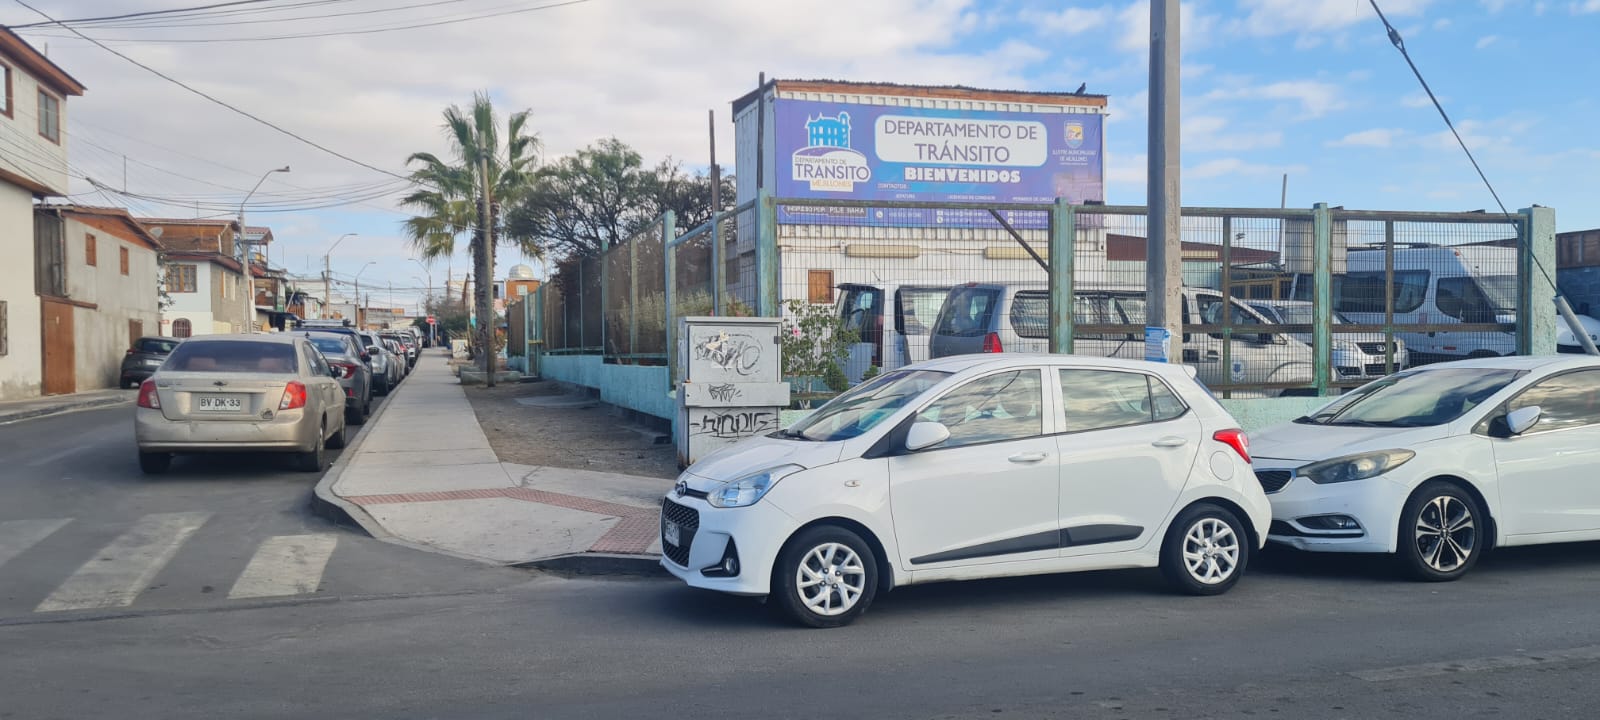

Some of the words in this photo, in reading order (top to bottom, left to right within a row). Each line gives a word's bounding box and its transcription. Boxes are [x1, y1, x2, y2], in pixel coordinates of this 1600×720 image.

[884, 119, 1012, 140] DEPARTAMENTO
[1016, 125, 1038, 140] DE
[914, 140, 1011, 163] TRÁNSITO
[794, 163, 870, 180] TRANSITO
[904, 167, 1021, 184] BIENVENIDOS
